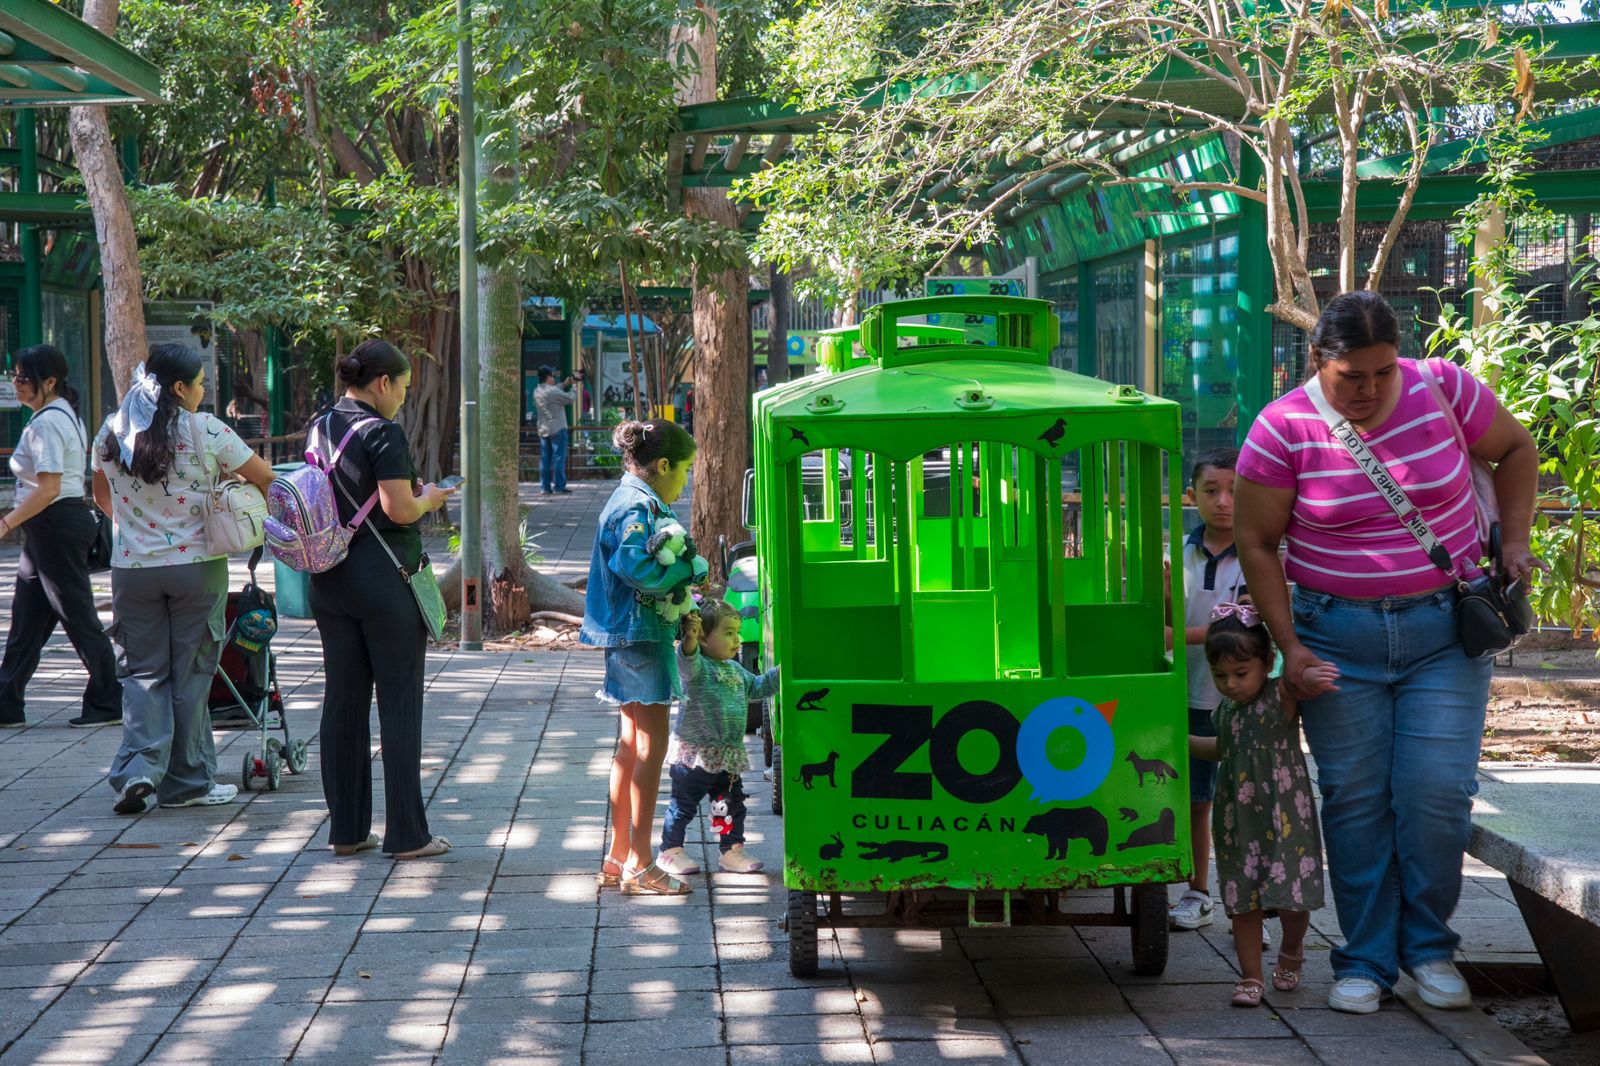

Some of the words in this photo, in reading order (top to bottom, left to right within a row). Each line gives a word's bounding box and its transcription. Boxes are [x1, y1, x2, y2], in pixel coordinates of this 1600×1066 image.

[935, 283, 964, 296] ZOO
[989, 283, 1019, 296] ZOO
[1338, 426, 1364, 455] LOLA
[1360, 457, 1371, 467] Y
[1371, 465, 1404, 506] BIMBA
[851, 696, 1116, 804] ZOO
[852, 812, 1016, 833] CULIACÁN
